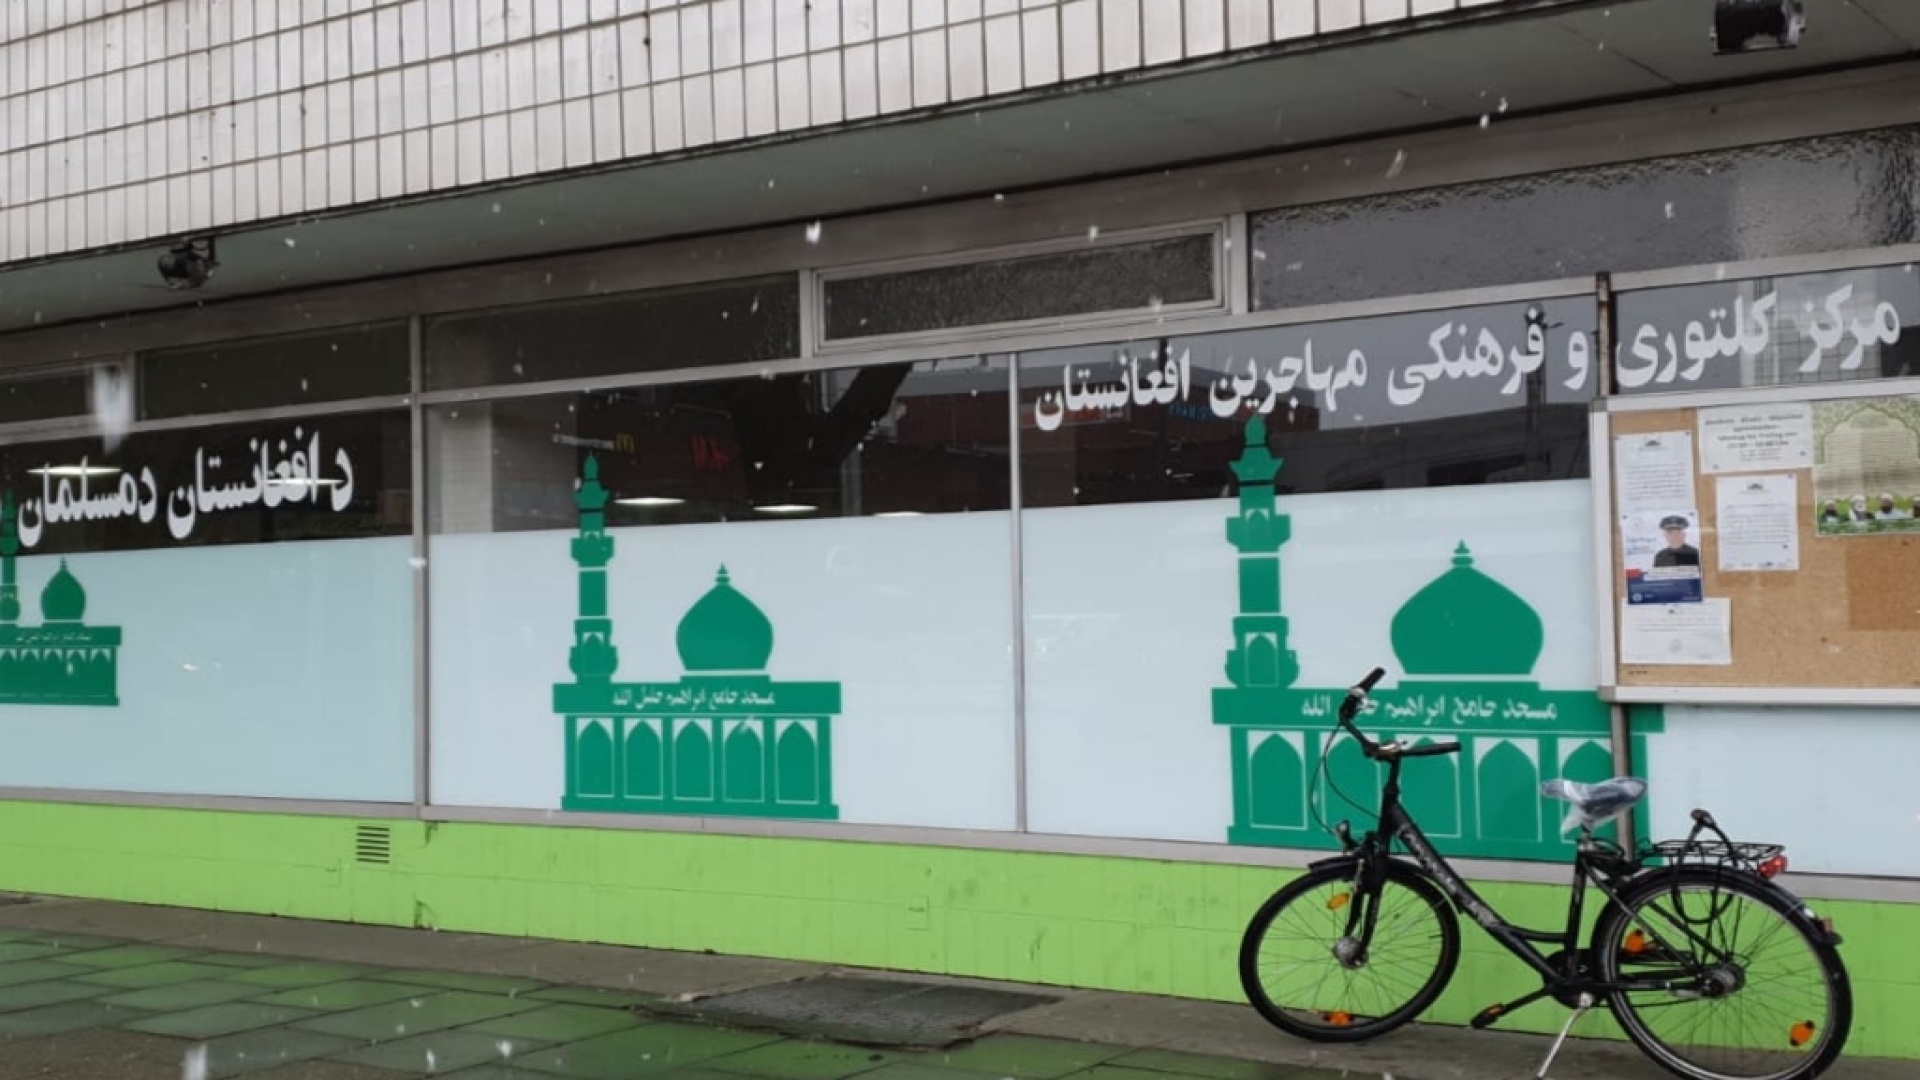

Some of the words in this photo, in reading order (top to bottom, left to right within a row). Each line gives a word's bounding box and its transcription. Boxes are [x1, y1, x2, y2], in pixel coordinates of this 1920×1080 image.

[1562, 331, 1589, 391] و
[1616, 290, 1778, 388] کلتوری
[1799, 282, 1900, 373] مرکز
[1034, 345, 1191, 431] افغانستان
[1210, 337, 1368, 418] مهاجرین
[166, 426, 320, 540] افغانستان
